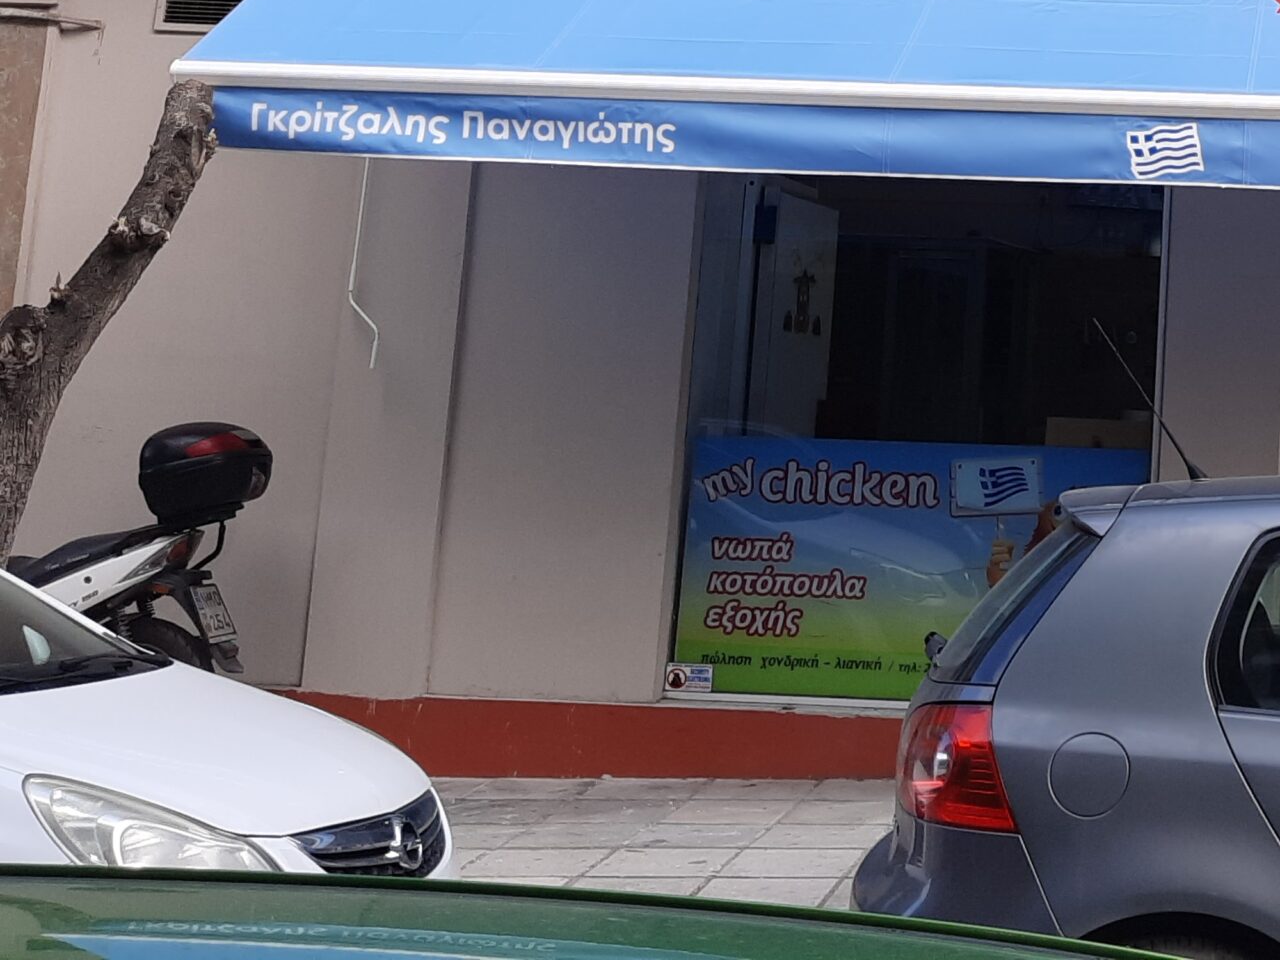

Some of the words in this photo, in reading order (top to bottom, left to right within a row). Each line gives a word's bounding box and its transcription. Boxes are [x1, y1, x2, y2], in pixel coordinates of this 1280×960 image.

[250, 100, 449, 144] Γκρίτζαλης
[461, 109, 677, 154] Παναγιώτης
[702, 457, 757, 502] my
[759, 458, 940, 508] chicken
[712, 531, 794, 562] νωπά
[707, 566, 867, 600] κοτόπουλα
[704, 598, 803, 638] εξοχής
[701, 651, 752, 666] πώληση
[760, 654, 818, 671] χονδρική
[834, 656, 882, 671] λιανική
